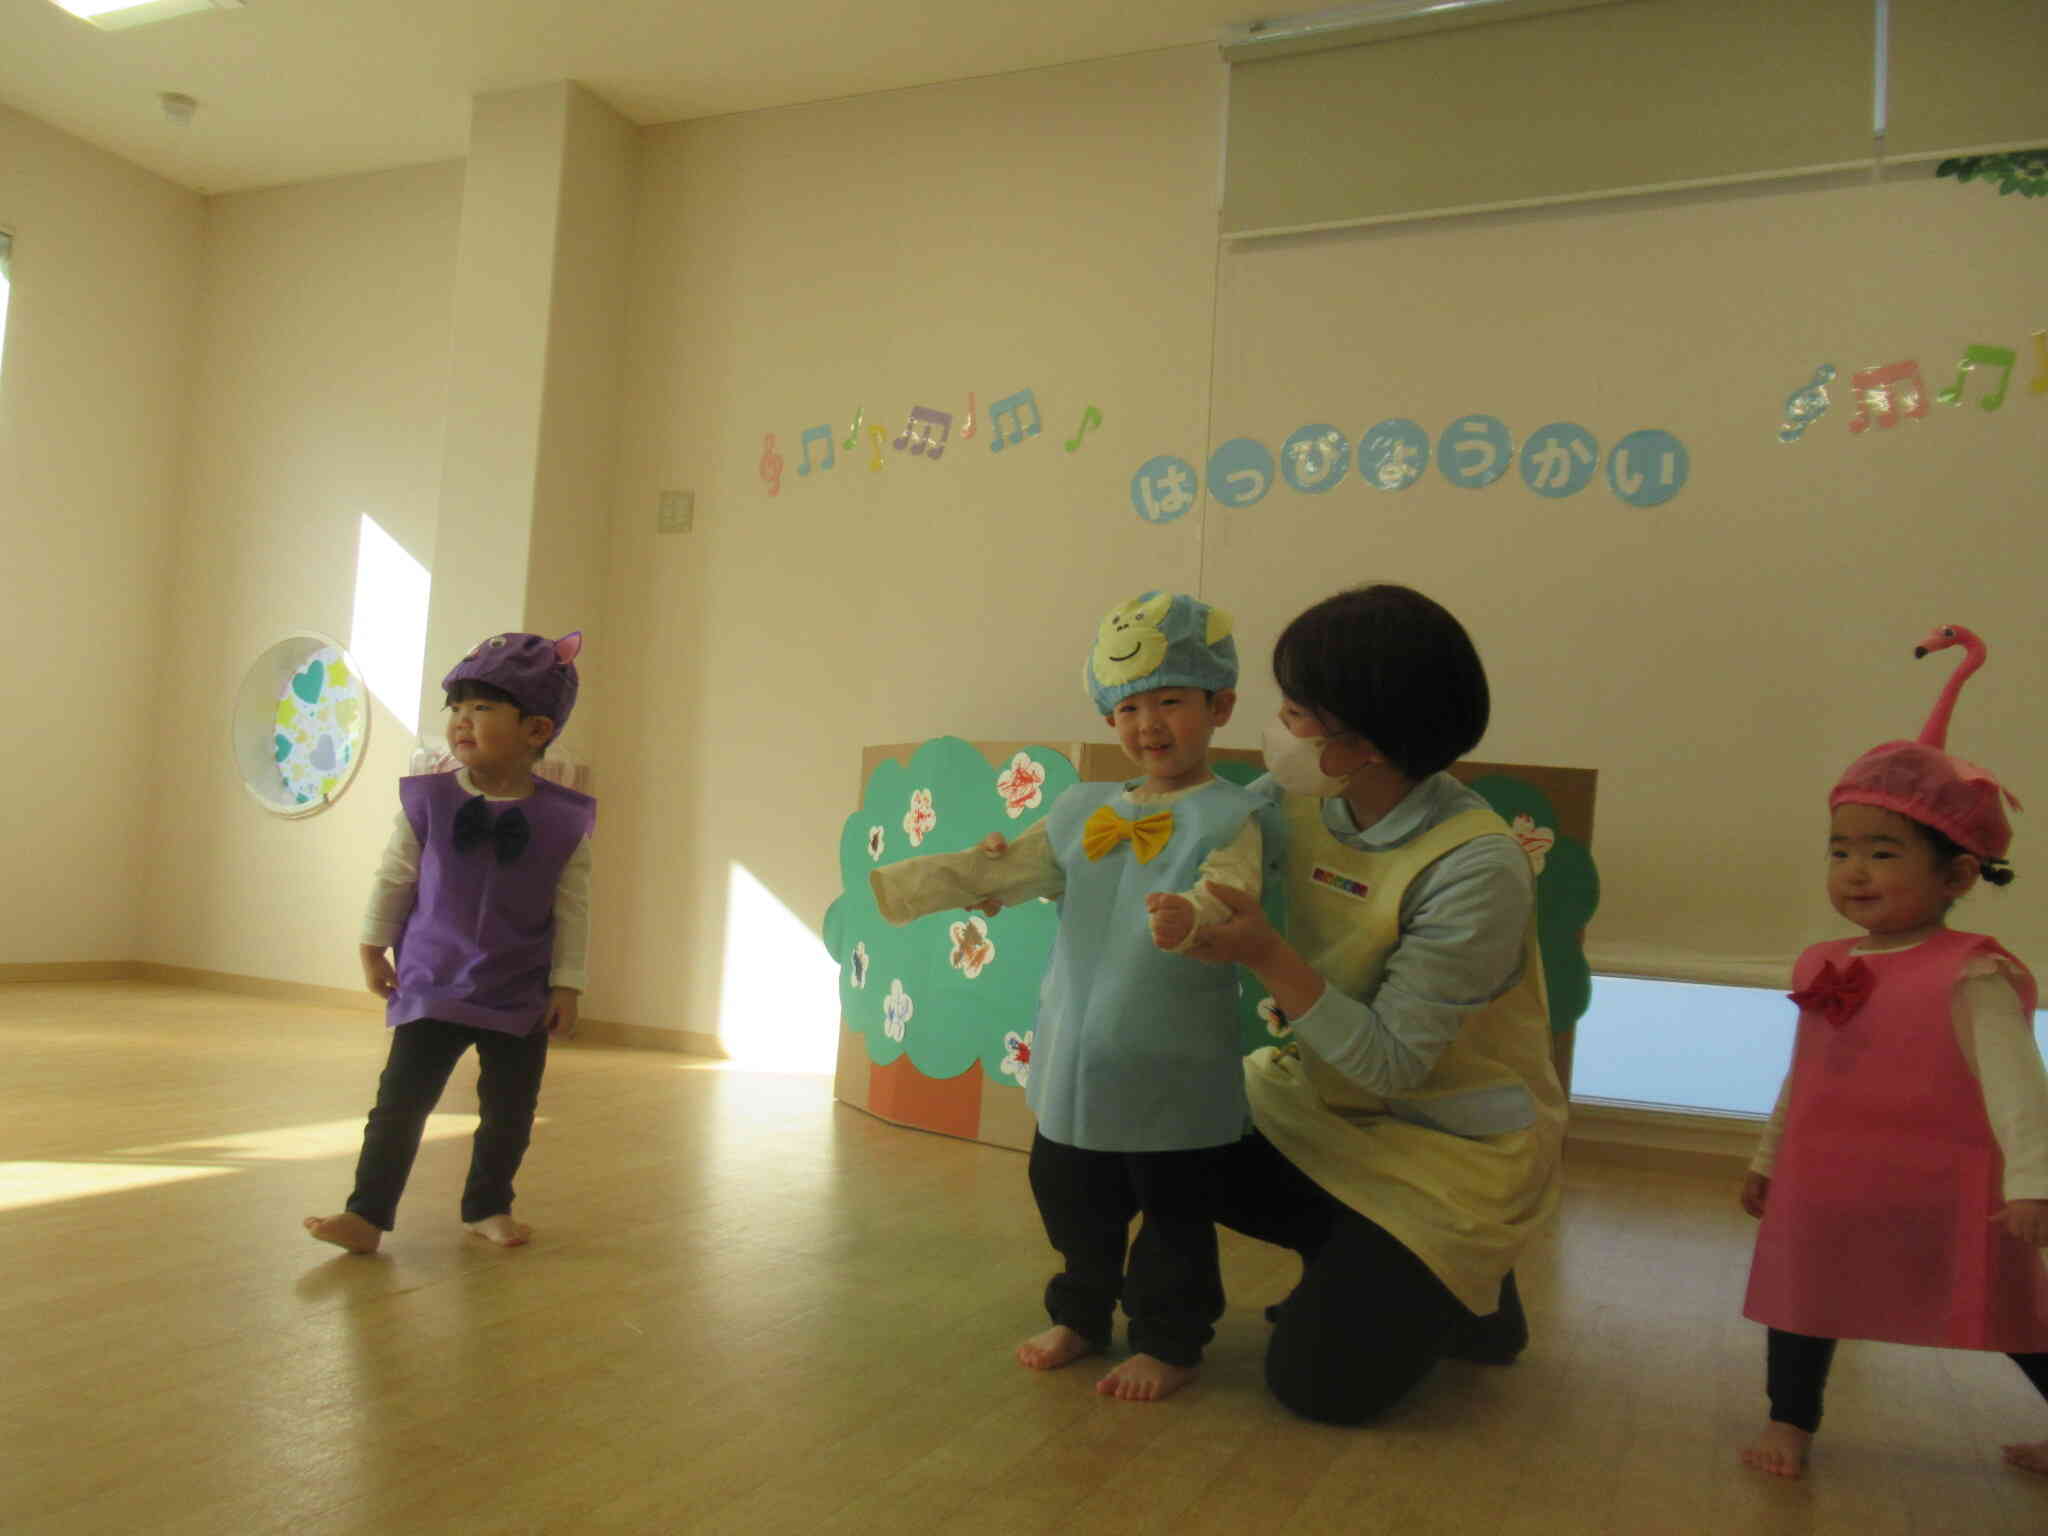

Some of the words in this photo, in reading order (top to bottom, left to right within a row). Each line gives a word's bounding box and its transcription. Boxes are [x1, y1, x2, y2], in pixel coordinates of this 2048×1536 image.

[1138, 420, 1676, 521] はっぴょうかい
